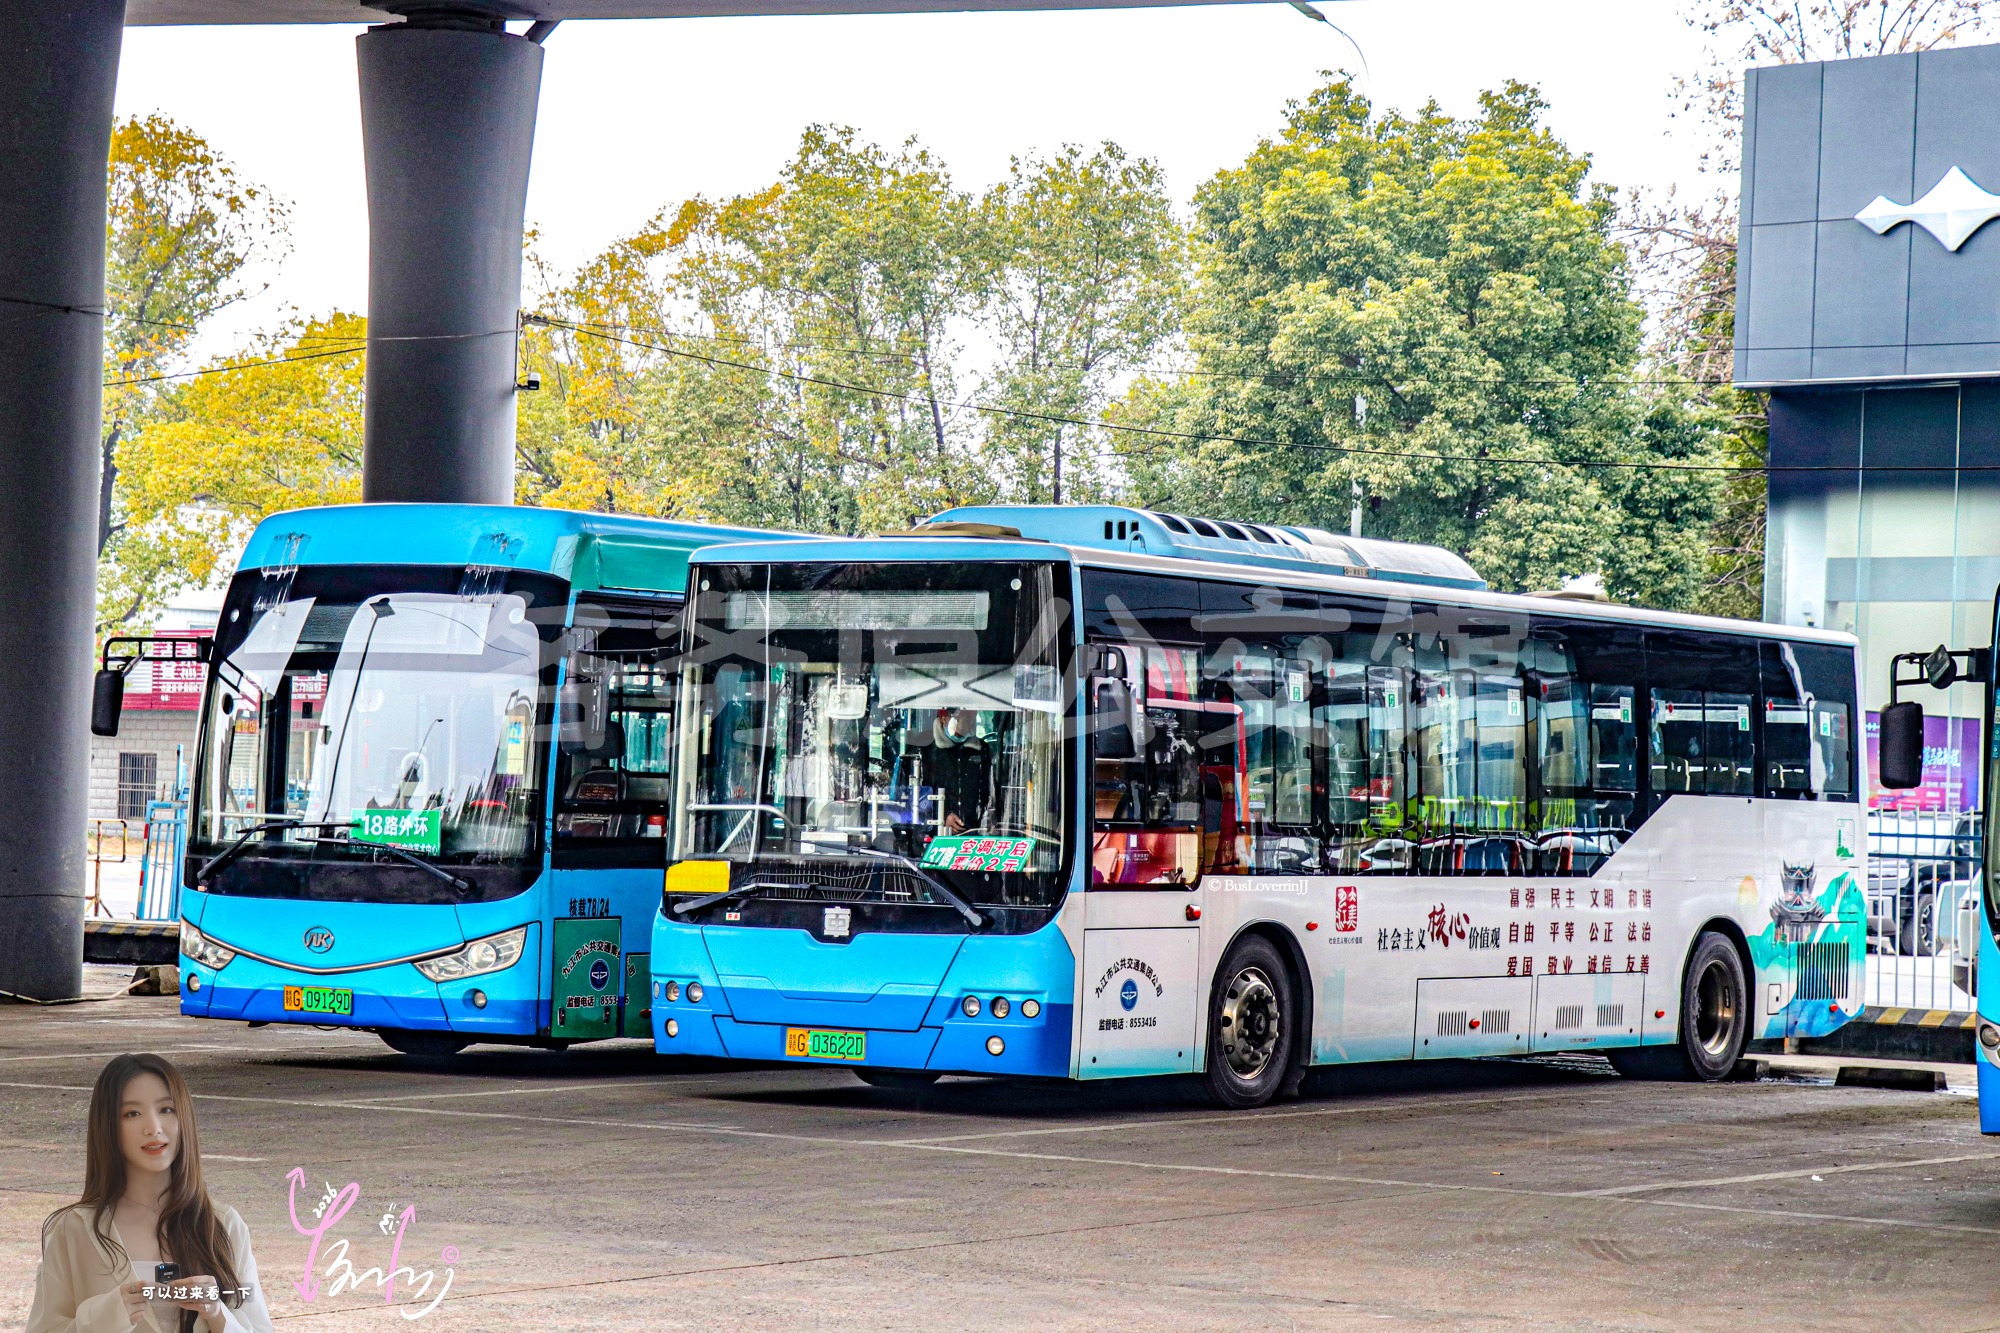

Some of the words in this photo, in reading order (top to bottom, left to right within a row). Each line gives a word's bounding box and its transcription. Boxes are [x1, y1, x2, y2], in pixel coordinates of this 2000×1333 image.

[362, 814, 428, 837] 18路外环
[958, 839, 1029, 857] 空调开启
[949, 855, 1020, 872] 票价2元
[1509, 887, 1536, 909] 富强
[1551, 888, 1575, 909] 民主
[1589, 888, 1614, 909] 文明
[1628, 889, 1652, 909] 和谐
[1378, 902, 1501, 951] 社会主义核心价值观
[1508, 921, 1535, 944] 自由
[1550, 921, 1575, 943] 平等
[1589, 921, 1614, 943] 公正
[1627, 921, 1651, 943] 法治
[1507, 956, 1533, 976] 爱国
[1548, 955, 1573, 974] 敬业
[1588, 954, 1612, 974] 诚信
[1626, 954, 1650, 974] 友善
[1095, 958, 1163, 998] 九江市公共交通集团公司
